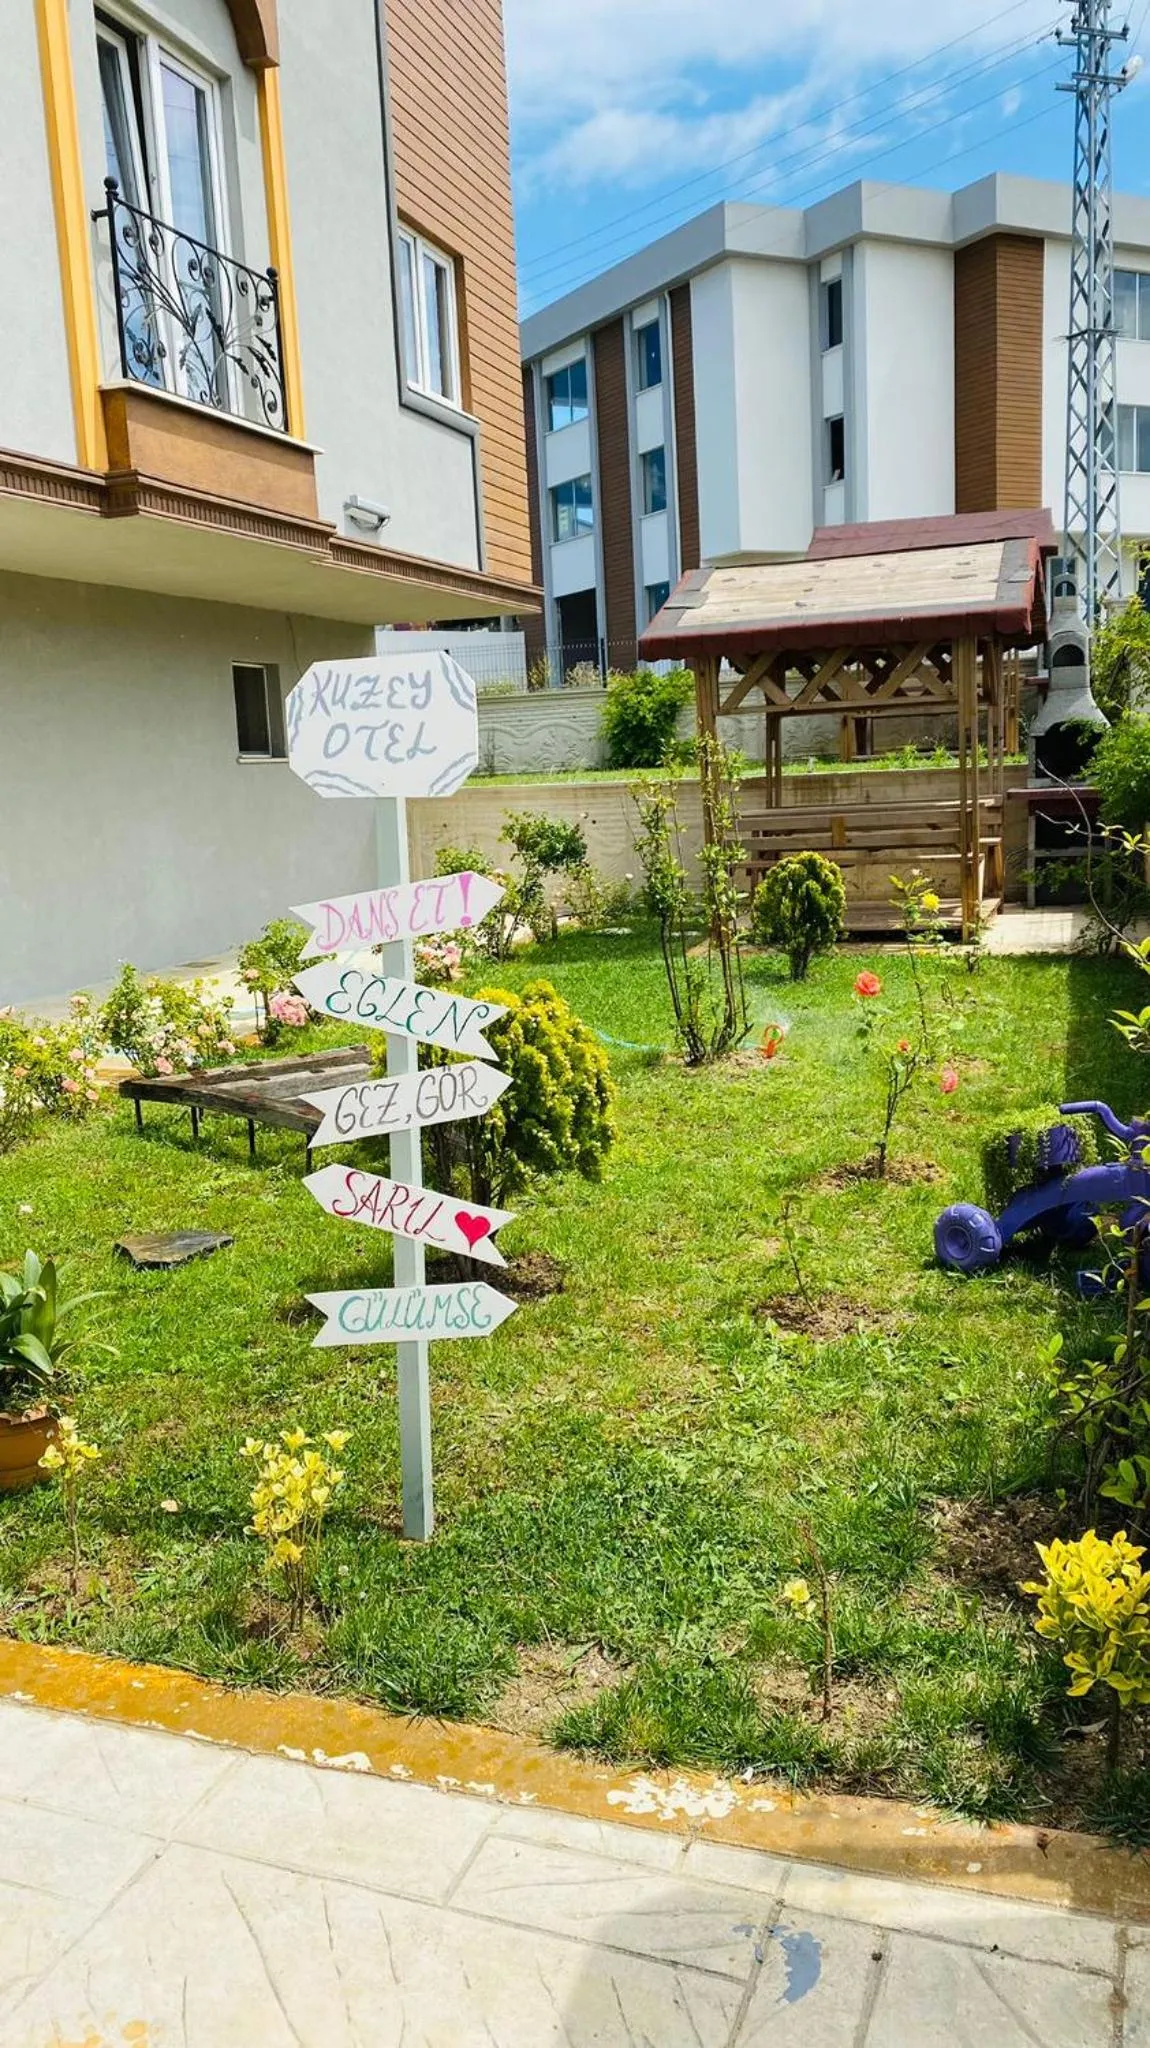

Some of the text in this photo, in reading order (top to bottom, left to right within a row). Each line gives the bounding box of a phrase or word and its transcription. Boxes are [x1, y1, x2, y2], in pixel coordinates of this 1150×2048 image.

[310, 669, 432, 717] KUZEY
[322, 720, 437, 764] OTEL
[338, 1285, 492, 1333] GÜLÜMSE
